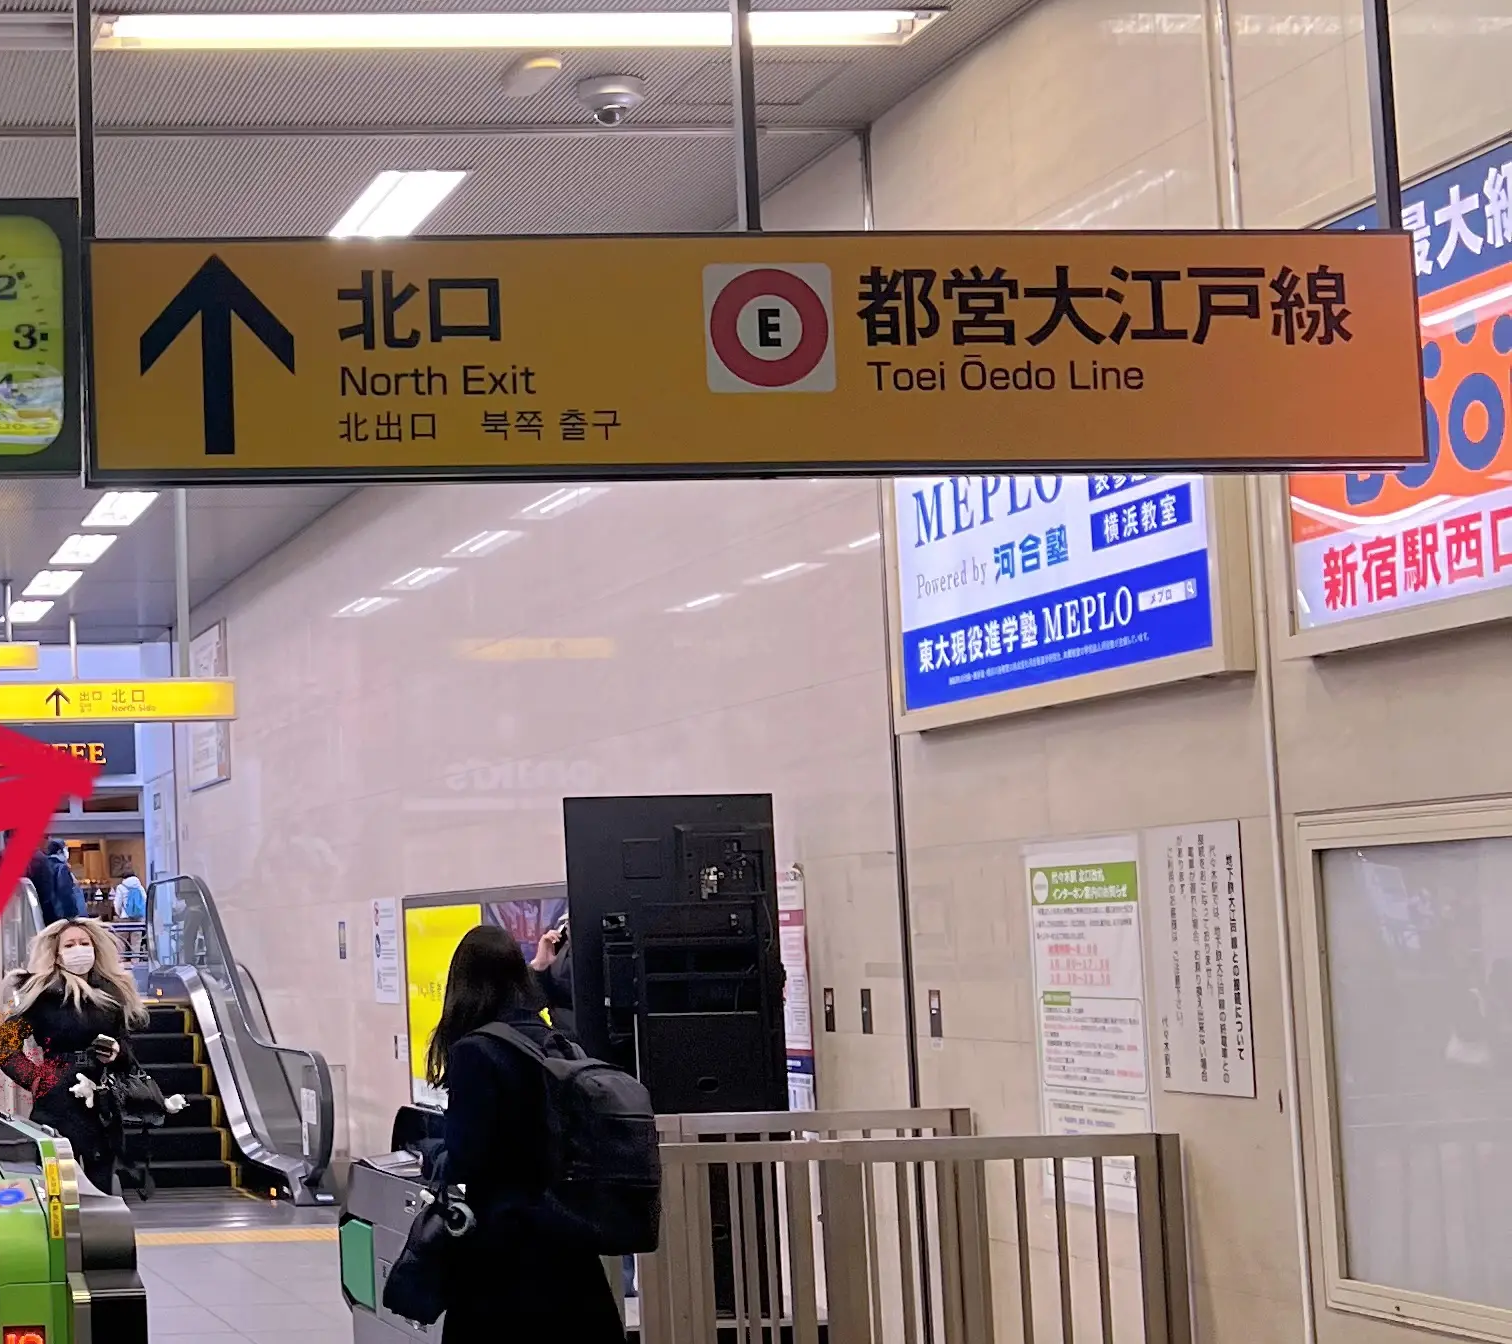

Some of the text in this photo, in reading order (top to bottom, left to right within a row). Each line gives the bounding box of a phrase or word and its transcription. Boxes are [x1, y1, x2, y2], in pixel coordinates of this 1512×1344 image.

[337, 269, 502, 351] 北口
[856, 263, 1355, 348] 都営大江戸線
[13, 323, 37, 350] 3
[758, 307, 782, 348] E
[339, 364, 537, 397] North Exit
[867, 353, 1145, 392] Toei Ōedo Line
[337, 411, 437, 443] 北出口
[481, 408, 623, 442] 북쪽 출구
[1103, 493, 1178, 544] 横浜教室
[916, 523, 1070, 600] Powered by 河合塾
[917, 611, 1039, 674] 東大現役進学塾
[1041, 585, 1133, 644] MEPLO
[111, 689, 145, 704] 北口
